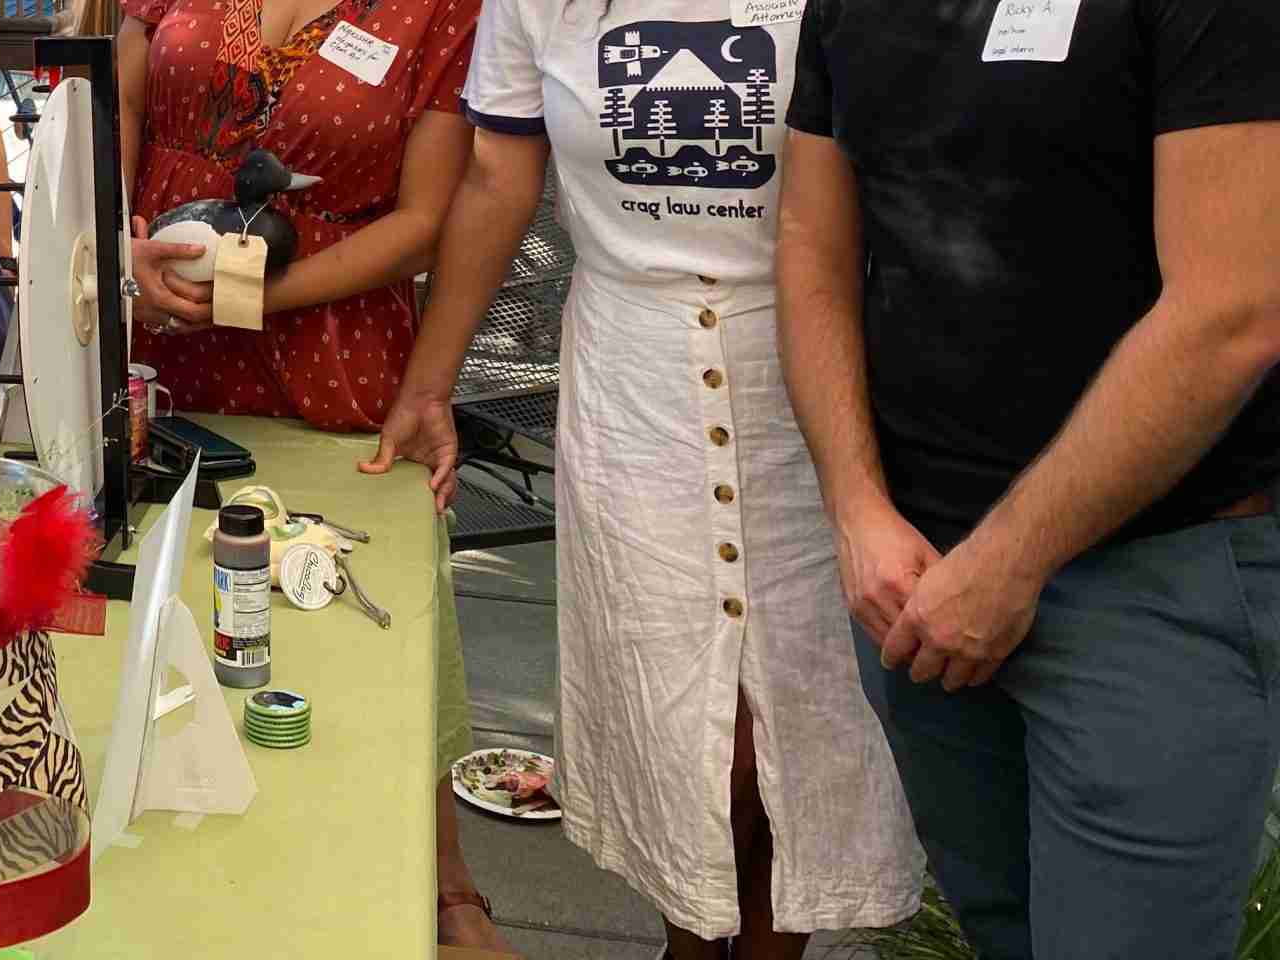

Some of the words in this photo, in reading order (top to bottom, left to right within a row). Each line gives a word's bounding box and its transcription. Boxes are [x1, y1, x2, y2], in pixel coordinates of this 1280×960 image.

[750, 9, 802, 24] Attorney
[621, 199, 662, 221] crag
[666, 196, 701, 216] law
[707, 199, 766, 219] center
